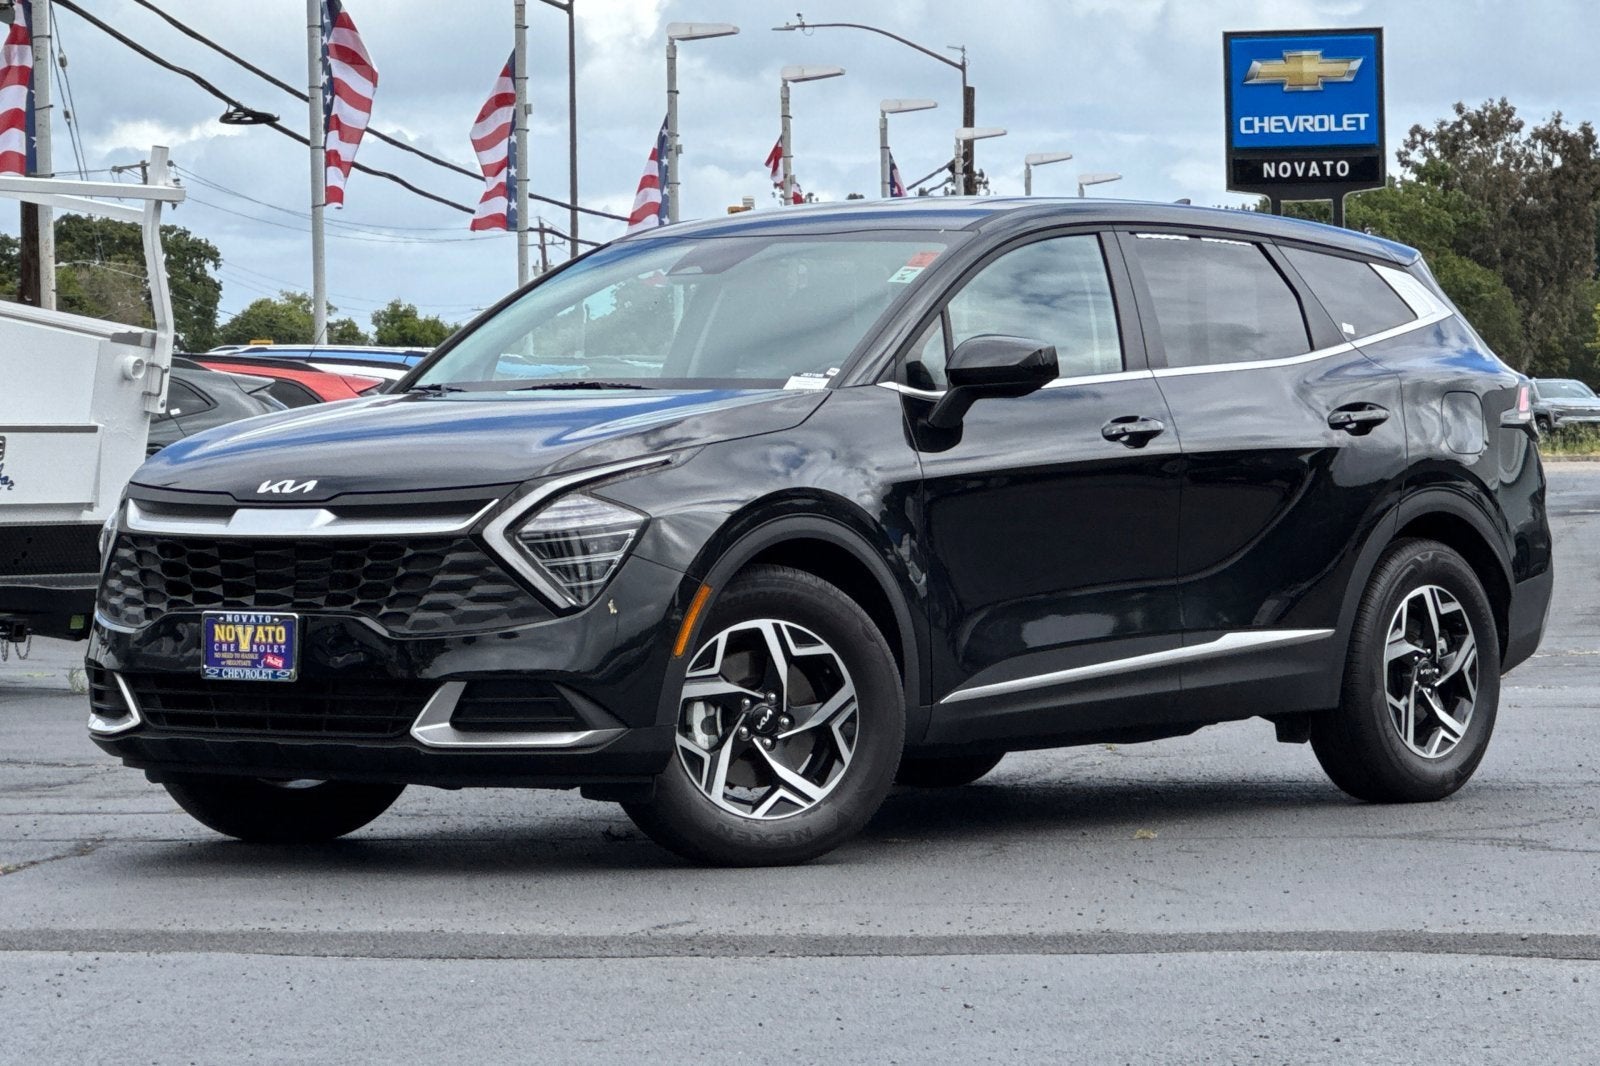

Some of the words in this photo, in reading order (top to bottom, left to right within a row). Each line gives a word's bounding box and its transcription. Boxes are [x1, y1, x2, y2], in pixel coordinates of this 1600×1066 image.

[1240, 113, 1369, 134] CHEVROLET
[1263, 160, 1350, 178] NOVATO
[257, 479, 318, 493] KIA
[226, 614, 271, 623] NOVATO
[214, 624, 286, 652] NOVATO
[222, 668, 273, 679] CHEVROLET
